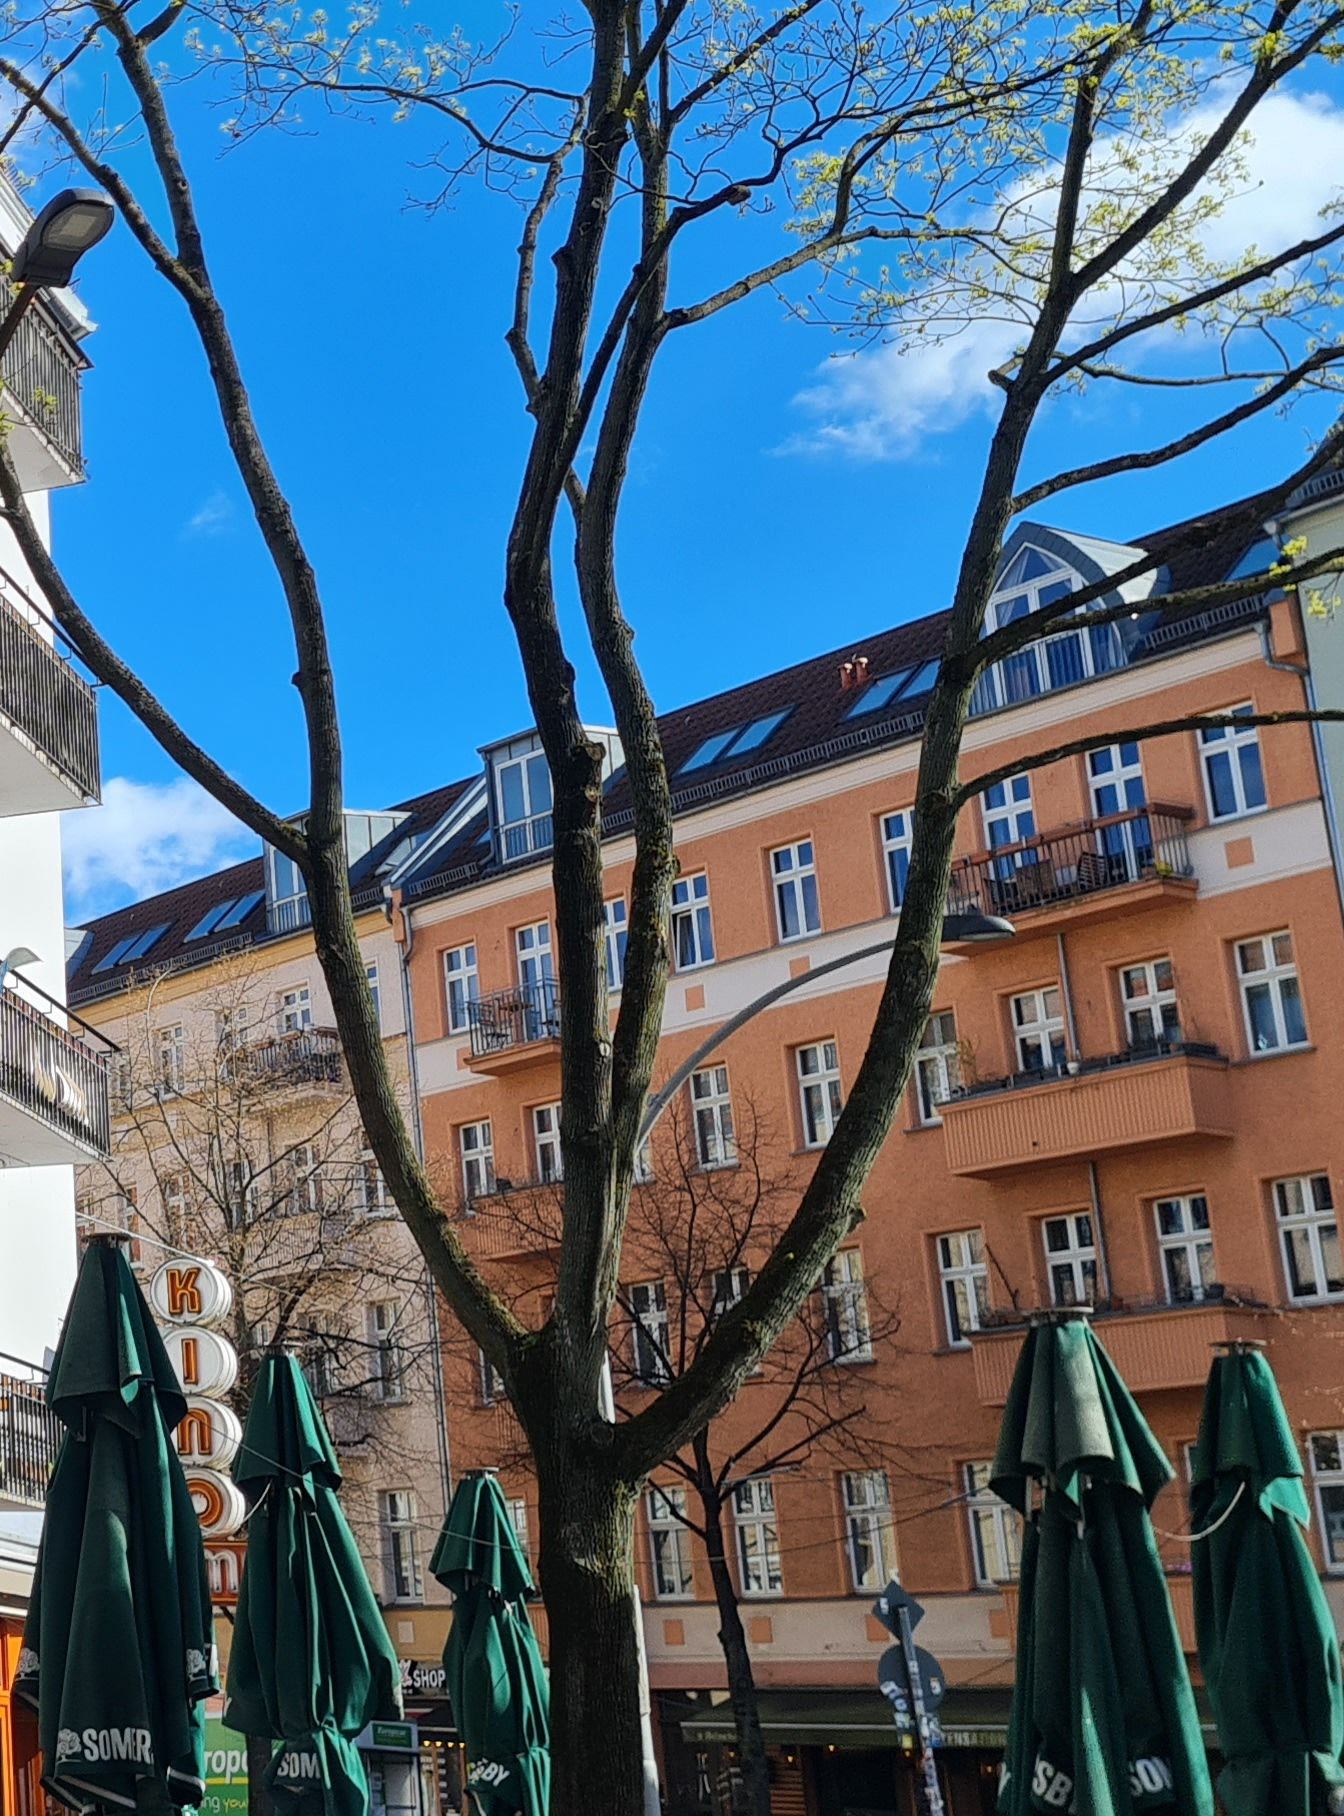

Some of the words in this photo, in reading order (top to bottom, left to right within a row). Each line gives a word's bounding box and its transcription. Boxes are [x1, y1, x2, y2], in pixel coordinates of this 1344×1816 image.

[166, 1266, 224, 1528] KINO
[412, 1669, 446, 1688] SHOP
[276, 1751, 322, 1779] SOM
